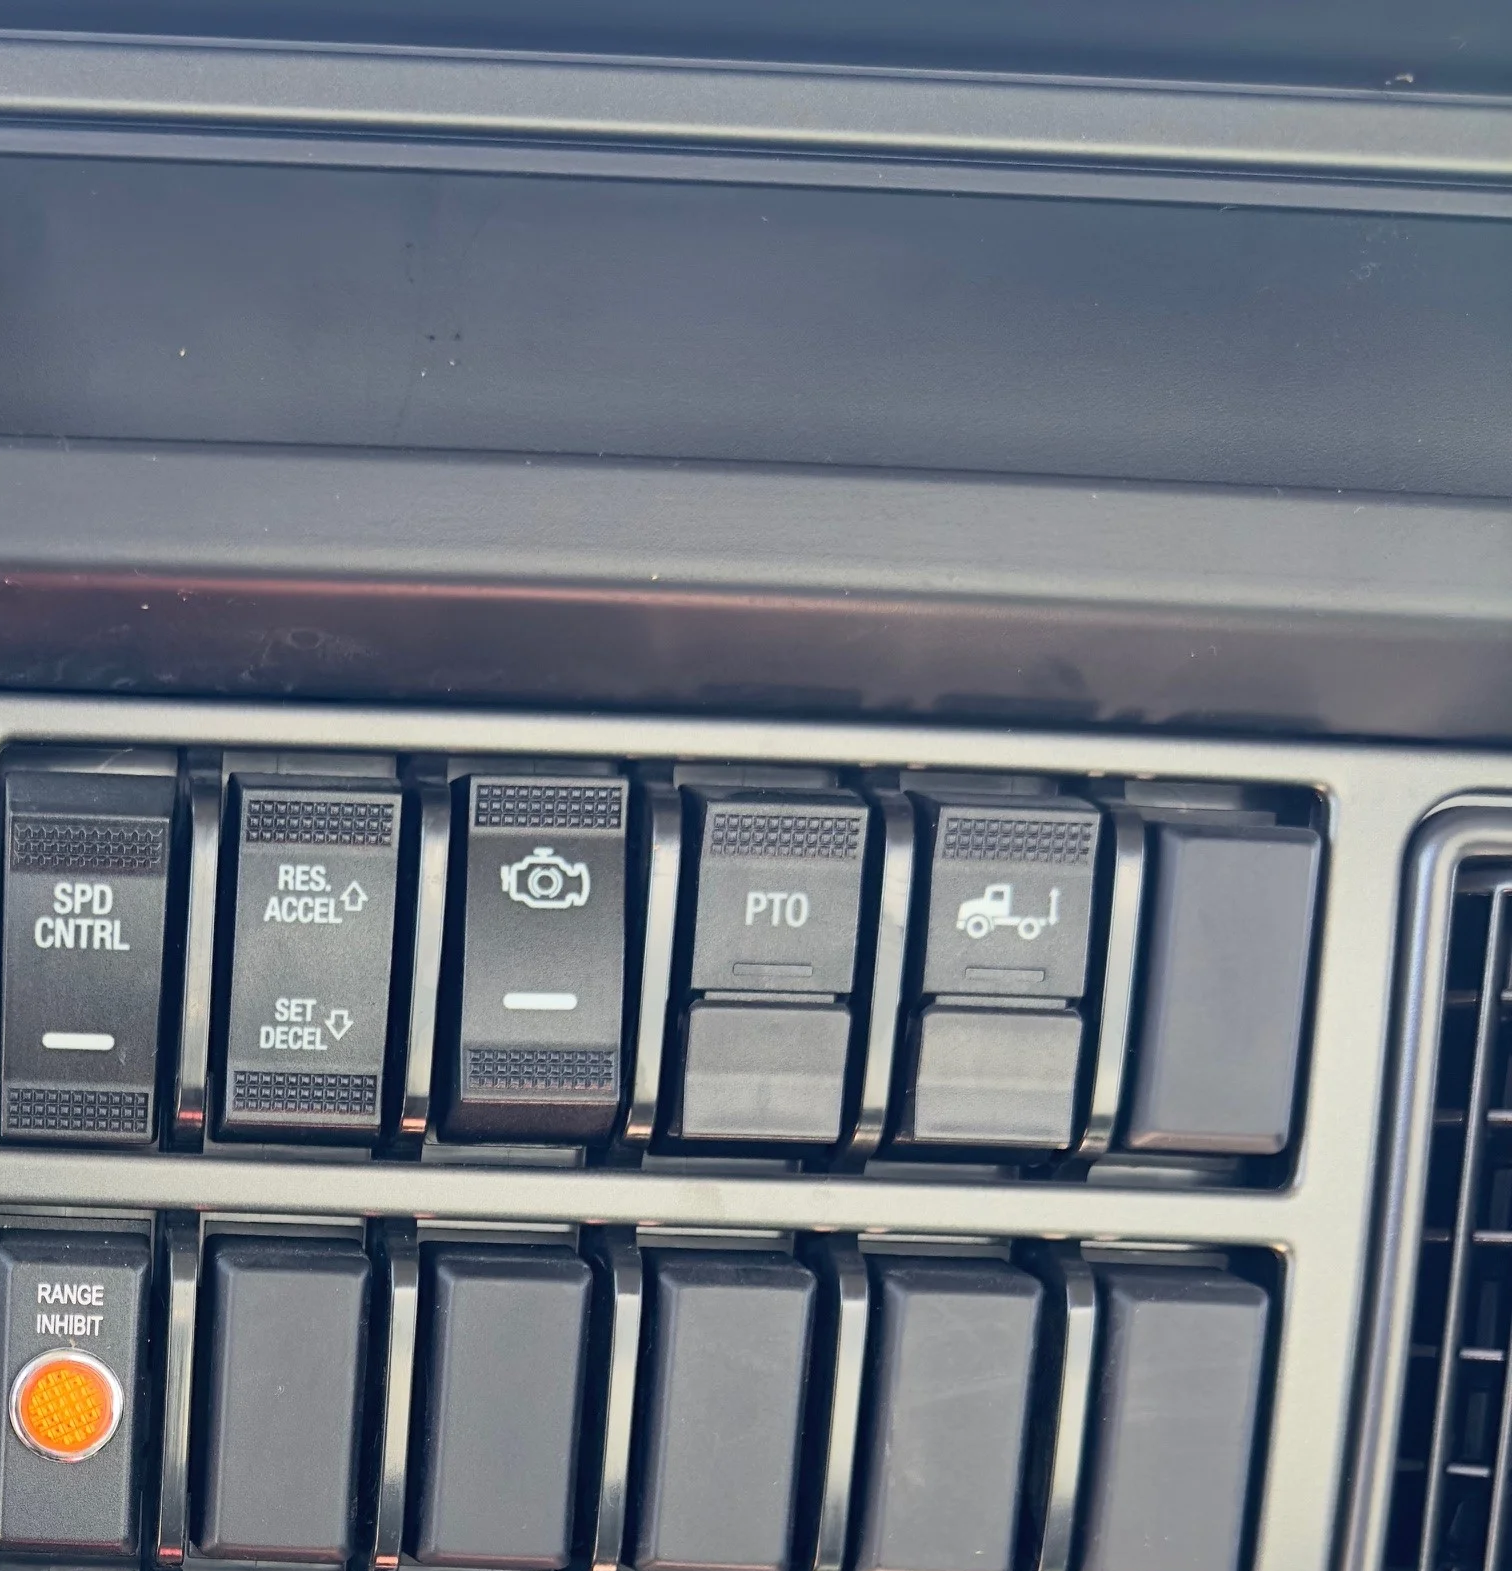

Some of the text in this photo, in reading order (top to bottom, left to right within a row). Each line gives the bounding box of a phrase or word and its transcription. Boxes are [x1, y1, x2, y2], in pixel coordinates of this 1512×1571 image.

[277, 865, 331, 892] RES.
[53, 883, 113, 915] SPD
[263, 896, 342, 924] ACCEL
[745, 891, 809, 928] PTO
[34, 918, 130, 951] CNTRL
[274, 998, 316, 1023] SET
[259, 1026, 327, 1051] DECEL
[37, 1283, 104, 1306] RANGE
[36, 1314, 103, 1336] INHIBIT
